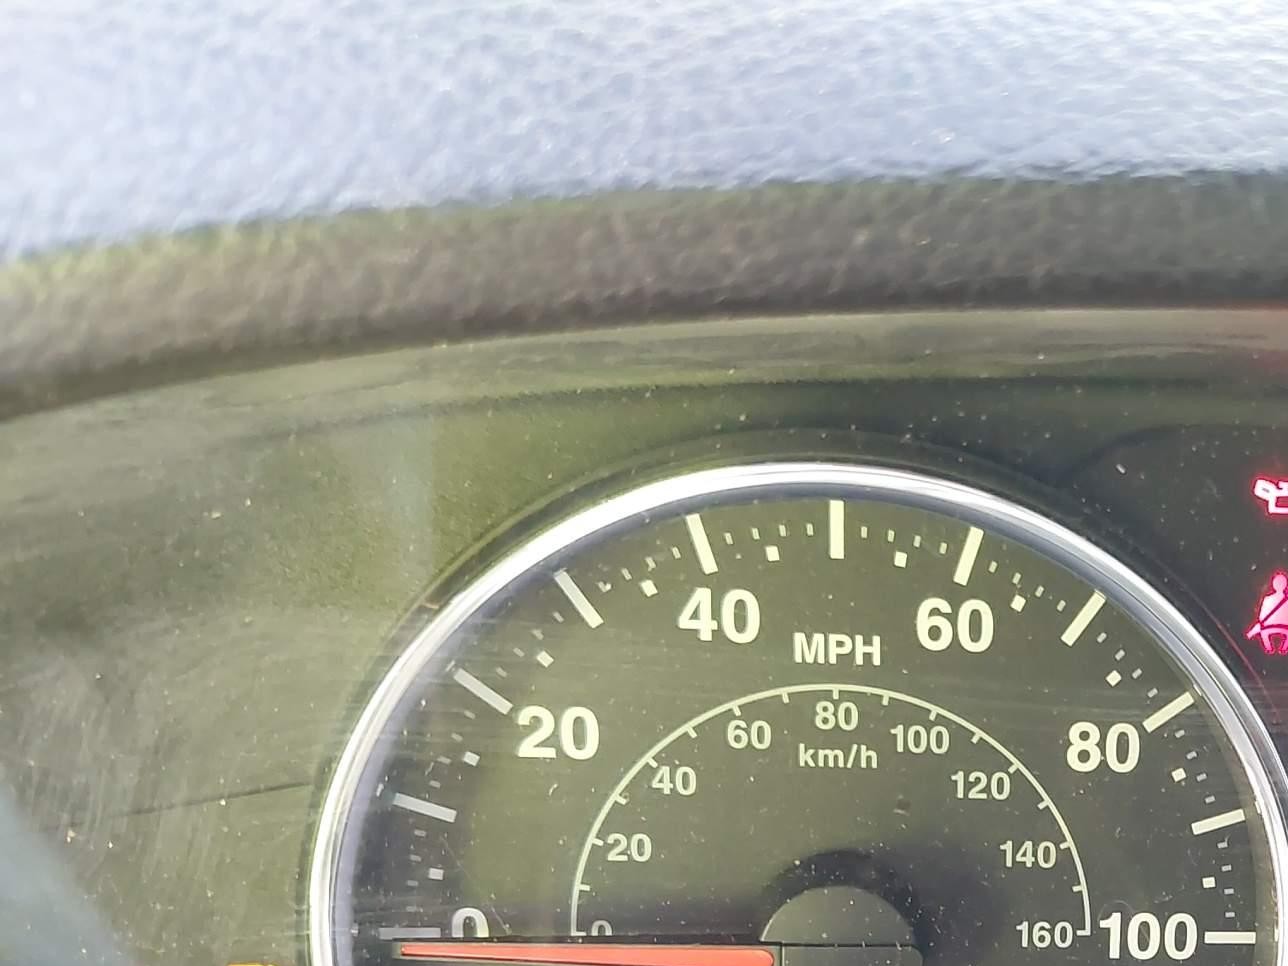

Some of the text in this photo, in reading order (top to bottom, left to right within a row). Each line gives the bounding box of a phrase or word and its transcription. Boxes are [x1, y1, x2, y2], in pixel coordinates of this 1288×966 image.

[677, 588, 762, 645] 40
[916, 598, 994, 653] 60
[793, 632, 882, 666] MPH
[814, 700, 859, 731] 80
[517, 706, 600, 760] 20
[728, 720, 772, 750] 60
[890, 725, 950, 756] 100
[1066, 721, 1141, 772] 80
[798, 741, 878, 770] km/h
[652, 766, 697, 796] 40
[951, 770, 1011, 802] 120
[607, 833, 652, 862] 20
[1000, 840, 1057, 869] 140
[451, 908, 489, 938] 0
[1015, 920, 1074, 949] 160
[1097, 912, 1199, 962] 100
